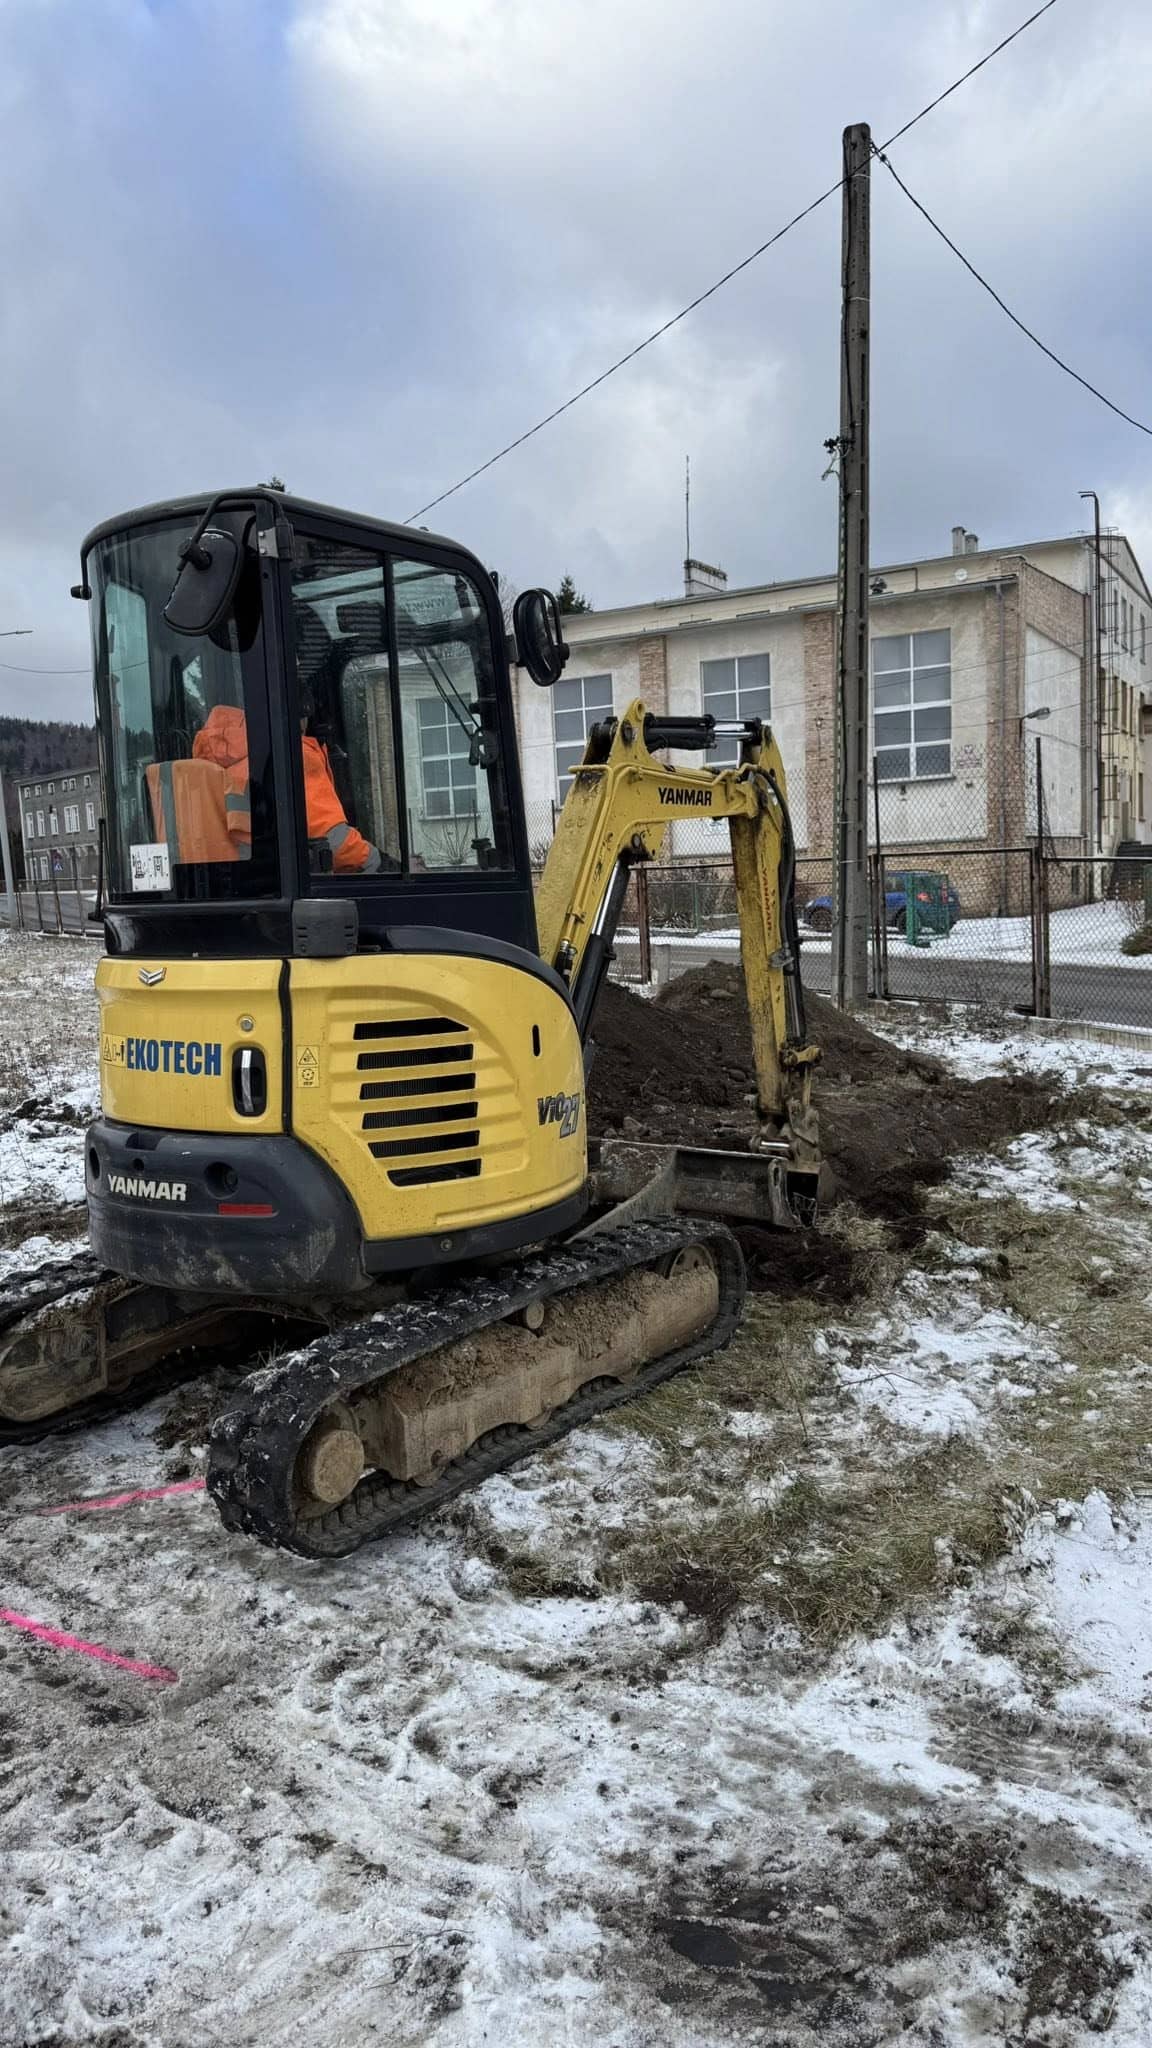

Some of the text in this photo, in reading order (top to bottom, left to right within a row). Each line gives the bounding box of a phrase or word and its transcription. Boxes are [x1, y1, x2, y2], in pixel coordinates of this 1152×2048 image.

[658, 787, 713, 807] YANMAR
[127, 1037, 222, 1076] EKOTECH
[107, 1173, 187, 1201] YANMAR
